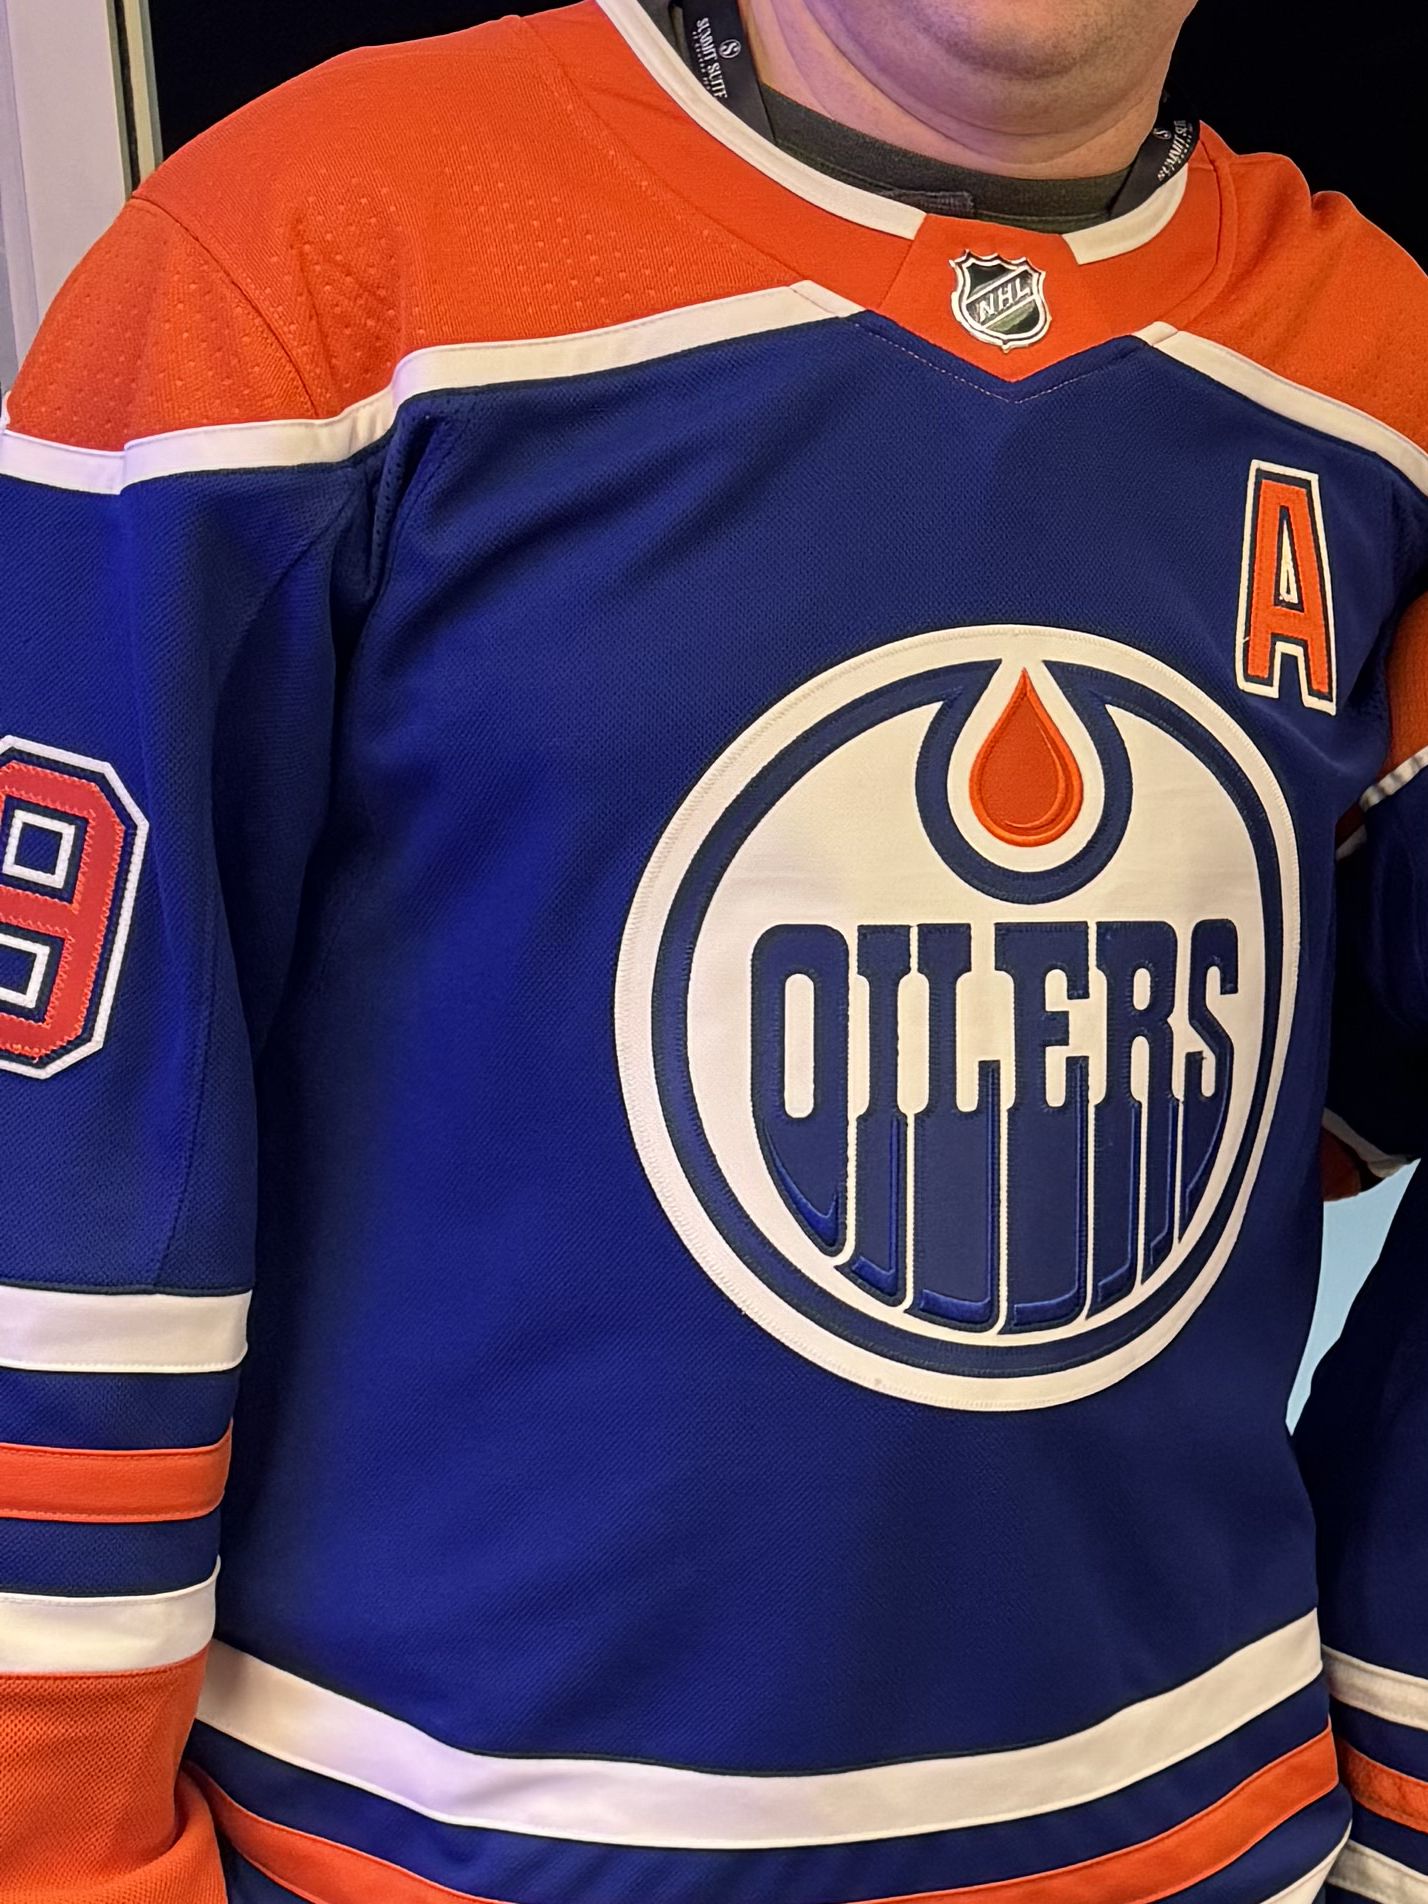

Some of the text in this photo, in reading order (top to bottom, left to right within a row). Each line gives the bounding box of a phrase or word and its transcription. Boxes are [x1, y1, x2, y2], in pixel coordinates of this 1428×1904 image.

[696, 17, 718, 61] SUMMIT
[976, 277, 1031, 324] NHL
[1235, 459, 1337, 716] A
[750, 918, 1239, 1335] OILERS
